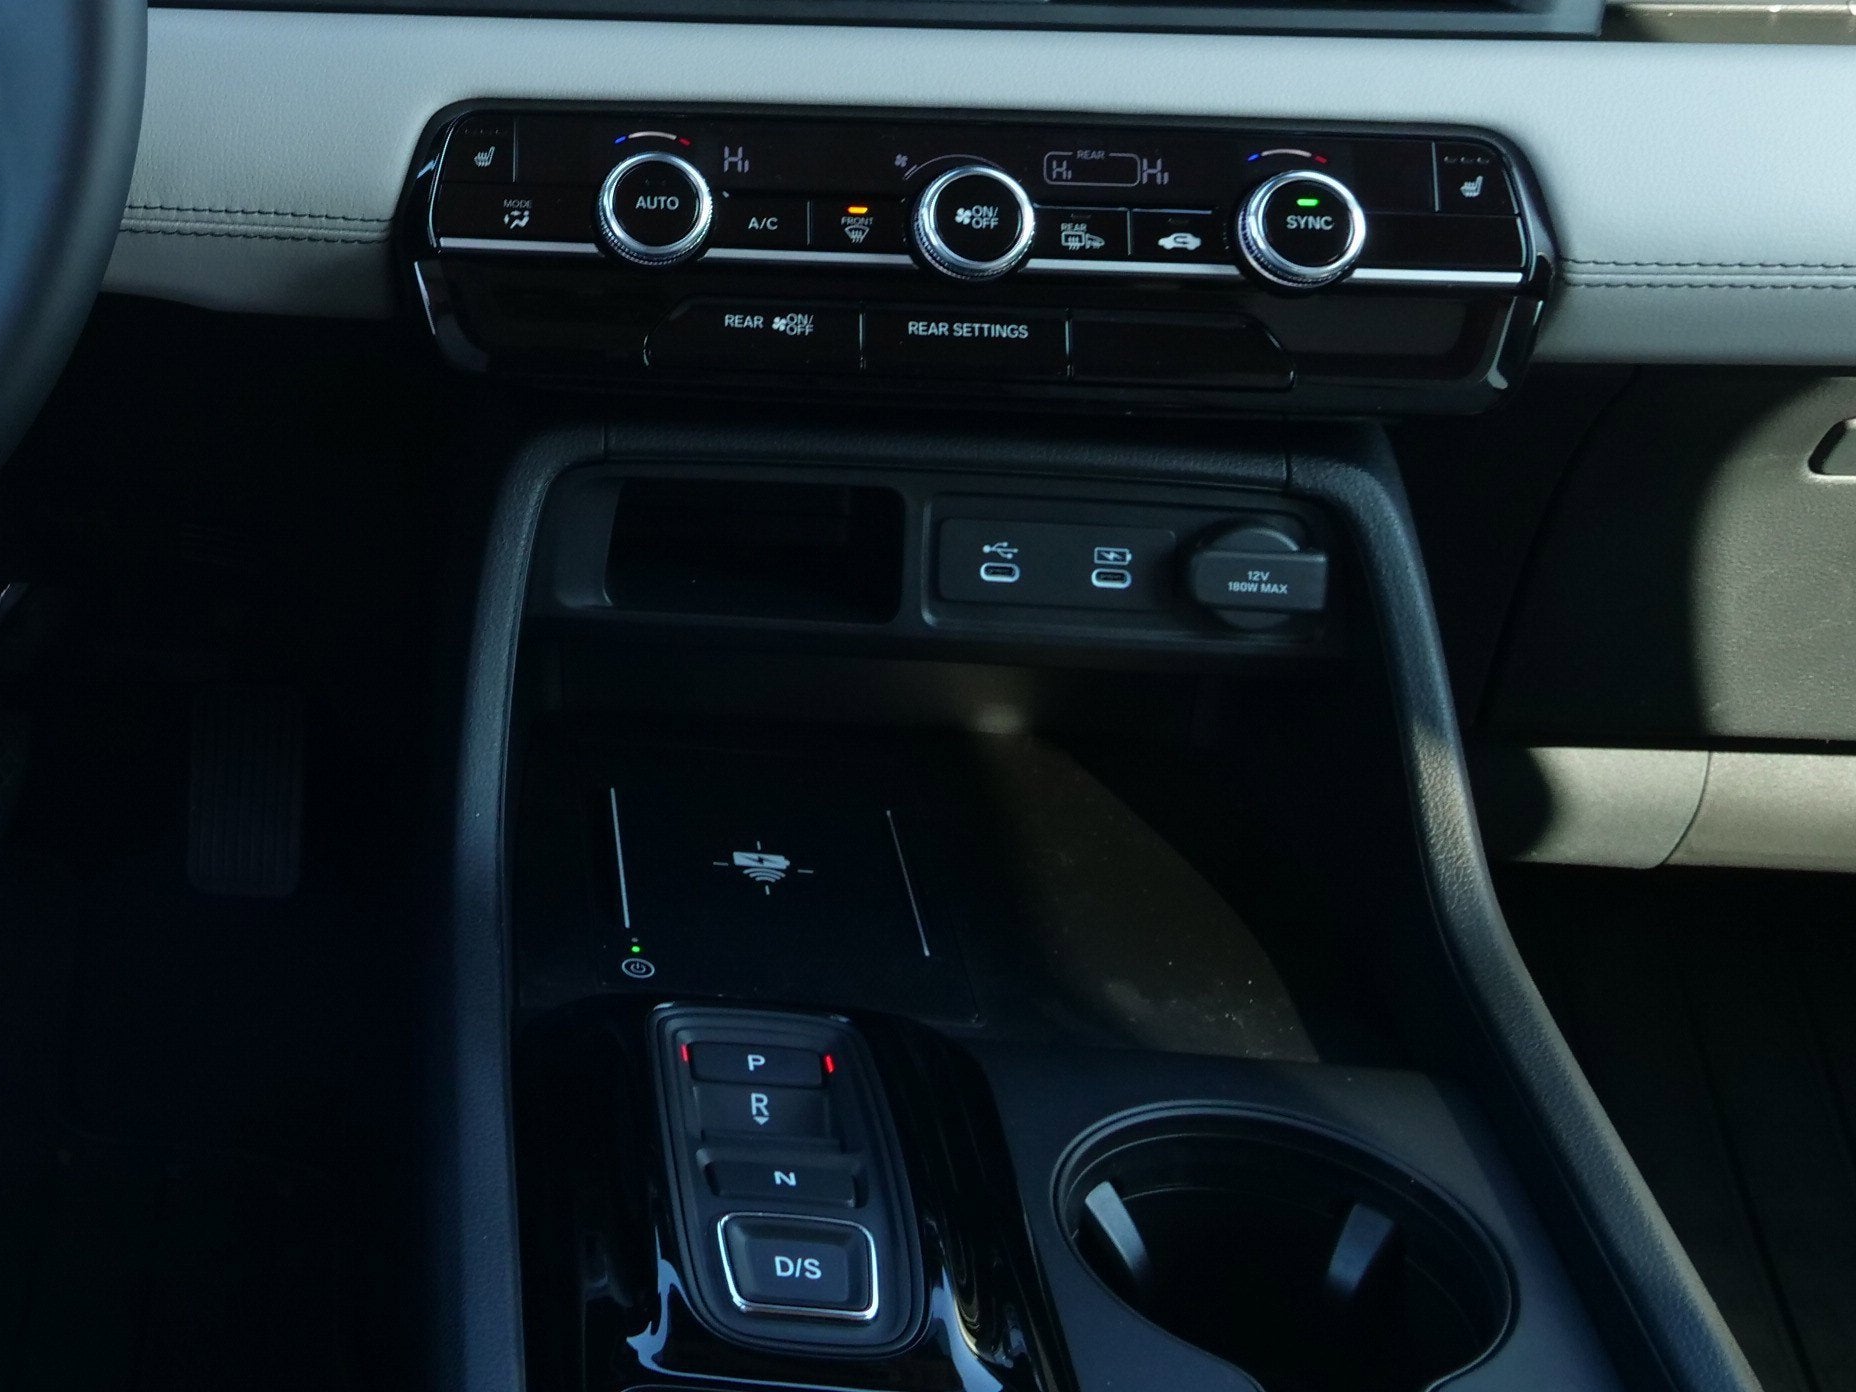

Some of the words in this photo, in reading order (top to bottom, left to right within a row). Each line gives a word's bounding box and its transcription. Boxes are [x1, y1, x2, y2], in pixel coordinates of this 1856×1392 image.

[1077, 151, 1105, 159] REAR
[503, 199, 533, 209] MODE
[635, 196, 679, 211] AUTO
[972, 204, 999, 217] ON/
[748, 216, 779, 232] A/C
[840, 216, 874, 226] FRONT
[972, 216, 999, 230] OFF
[1061, 222, 1087, 233] REAR
[1286, 215, 1334, 231] SYNC
[724, 314, 764, 329] REAR
[786, 314, 814, 325] ON/
[785, 324, 813, 336] OFF
[908, 321, 950, 337] REAR
[953, 322, 1029, 339] SETTINGS
[1248, 570, 1270, 581] 12V
[1227, 581, 1259, 593] 180W
[1260, 583, 1288, 594] MAX
[747, 1055, 766, 1071] P
[752, 1094, 768, 1116] R
[774, 1171, 797, 1186] N
[775, 1255, 822, 1280] D/S
